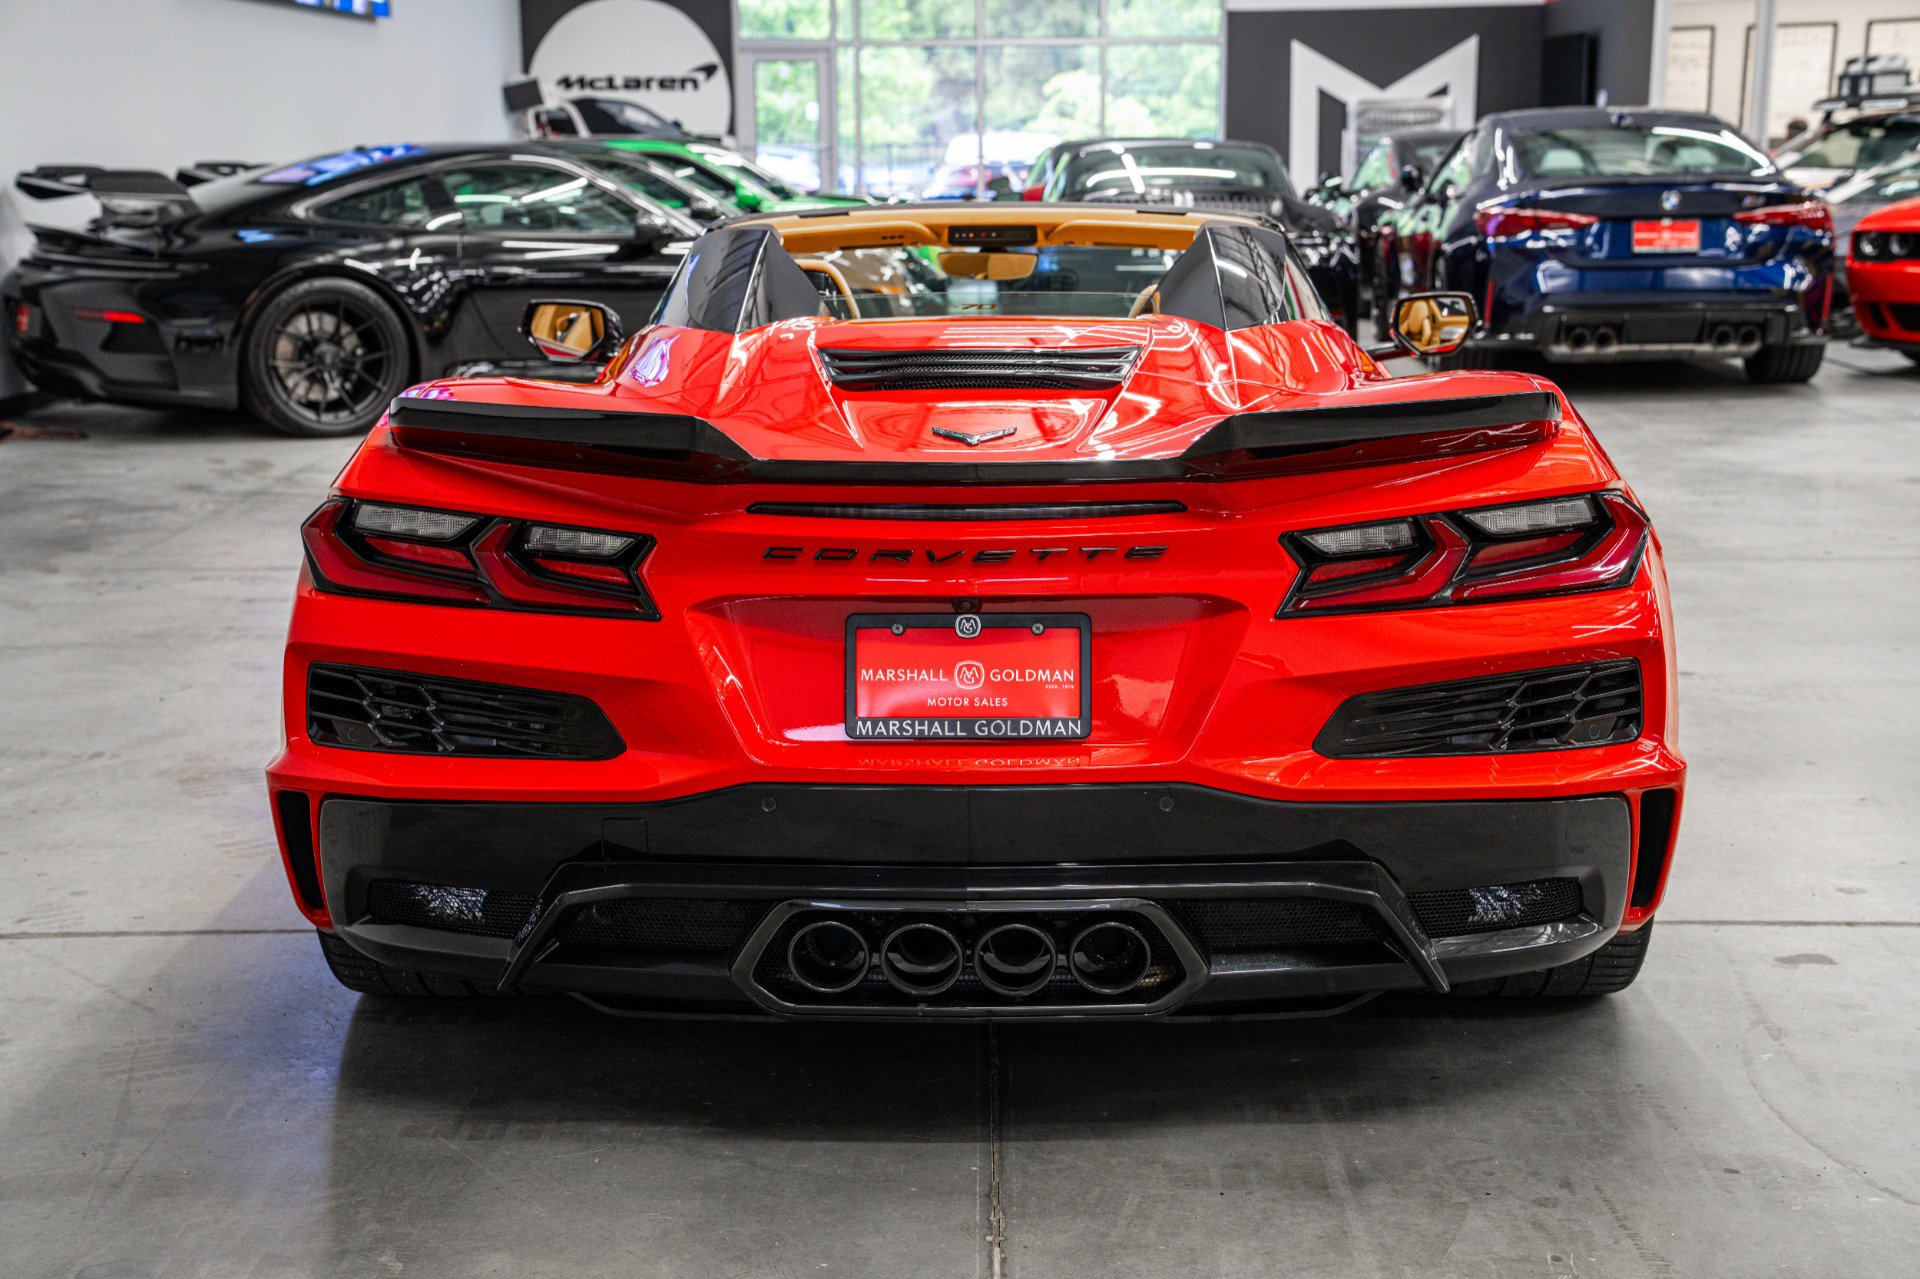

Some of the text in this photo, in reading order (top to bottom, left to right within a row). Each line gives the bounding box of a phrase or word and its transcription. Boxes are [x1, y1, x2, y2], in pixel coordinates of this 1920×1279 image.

[557, 76, 699, 91] McLaren
[761, 545, 1168, 563] CORVETTE
[861, 669, 948, 682] MARSHALL
[990, 669, 1074, 682] GOLDMAN
[927, 697, 1008, 706] MOTOR SALES
[856, 719, 1081, 736] MARSHALL GOLDMAN
